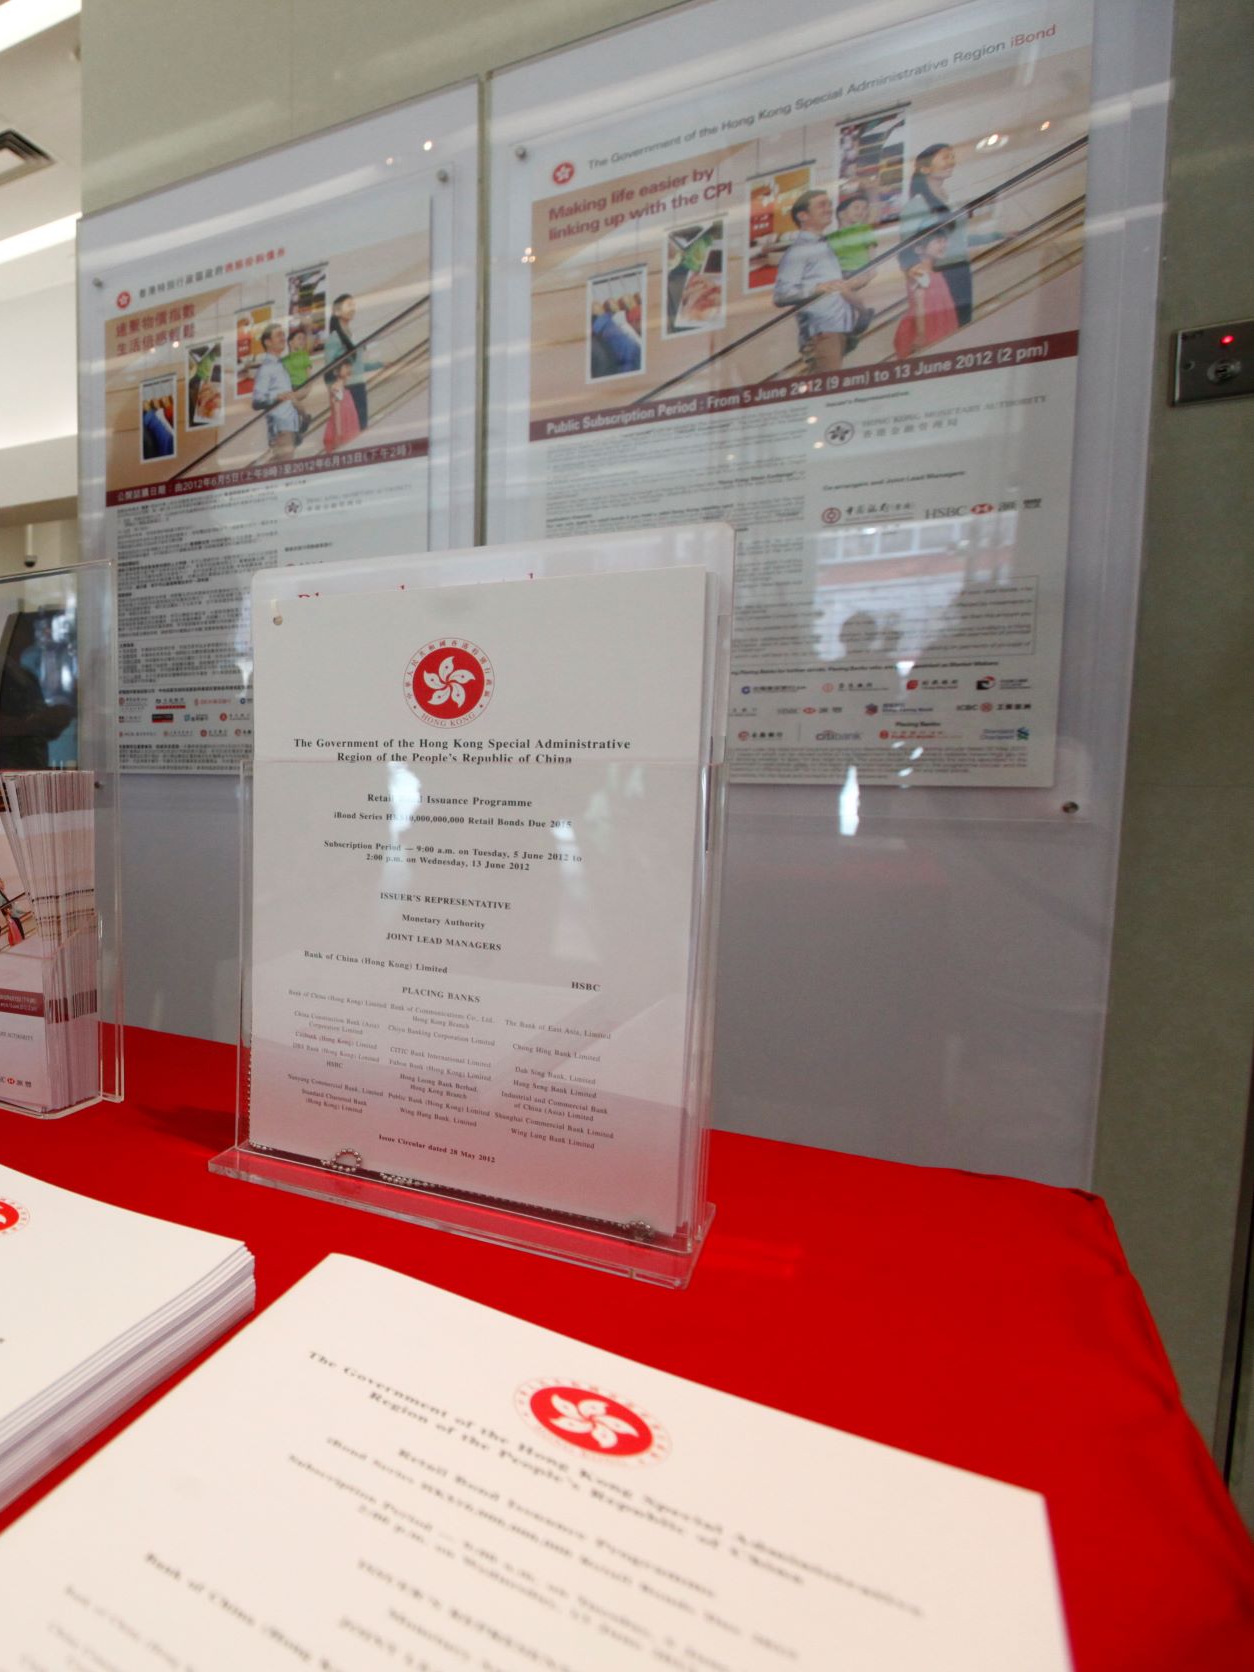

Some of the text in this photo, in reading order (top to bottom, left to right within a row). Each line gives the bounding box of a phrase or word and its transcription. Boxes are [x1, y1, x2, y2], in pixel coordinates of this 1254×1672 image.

[589, 24, 1057, 170] The Government of the Hong Kong Special Administrative Region iBond
[549, 167, 715, 222] Making life easier by
[549, 181, 733, 241] linking up with the CPI
[547, 421, 581, 435] Public
[583, 406, 655, 429] Subscription
[657, 400, 697, 417] Period
[707, 393, 740, 411] From
[743, 389, 752, 403] 5
[754, 385, 787, 402] June
[826, 376, 840, 391] (9
[842, 371, 871, 388] am)
[874, 370, 890, 382] to
[895, 365, 911, 379] 13
[914, 358, 952, 376] June
[956, 350, 993, 369] 2012
[996, 348, 1012, 365] (2
[1016, 342, 1049, 363] pm)
[925, 505, 968, 520] HSBC
[421, 712, 476, 727] HONG KONG
[294, 738, 631, 750] The Government of the Hong Kong Special Administrative
[337, 752, 573, 765] Region of the People's Republic of China
[367, 793, 393, 803] Retai
[427, 795, 469, 805] Issuance
[473, 796, 533, 808] Programme
[334, 811, 357, 819] iBond
[358, 812, 383, 821] Series
[468, 816, 494, 826] Retail
[497, 817, 525, 827] Bonds
[528, 819, 546, 828] Due
[324, 840, 373, 850] Subscription
[376, 842, 402, 851] Period
[416, 844, 435, 853] 9:00
[437, 846, 456, 855] a.m.
[472, 848, 510, 859] Tuesday,
[513, 849, 520, 858] 5
[522, 850, 544, 860] June
[547, 852, 569, 862] 2012
[366, 853, 383, 862] 2:00
[385, 856, 404, 865] p.m.
[420, 856, 469, 868] Wednesday,
[472, 859, 482, 868] 13
[484, 860, 506, 870] June
[509, 862, 531, 871] 2012
[424, 895, 512, 911] REPRESENTATIVE
[402, 913, 486, 930] Monetary Authority
[385, 932, 503, 951] JOINT LEAD MANAGERS
[304, 950, 449, 974] Bank of China (Hong Kong) Limited
[402, 986, 482, 1003] PLACING BANKS
[571, 981, 602, 993] HSBC
[378, 1133, 496, 1163] Issue Circular dated 28 May 2012
[308, 1351, 337, 1368] The
[343, 1366, 449, 1419] Government
[454, 1414, 476, 1429] of
[481, 1427, 510, 1445] the
[519, 1442, 571, 1473] Hong
[579, 1468, 633, 1499] Kong
[642, 1493, 724, 1534] Special
[369, 1391, 429, 1426] Region
[436, 1420, 456, 1437] of
[461, 1432, 491, 1452] the
[590, 1486, 685, 1535] Republic
[397, 1448, 449, 1478] Retail
[454, 1474, 501, 1502] Bond
